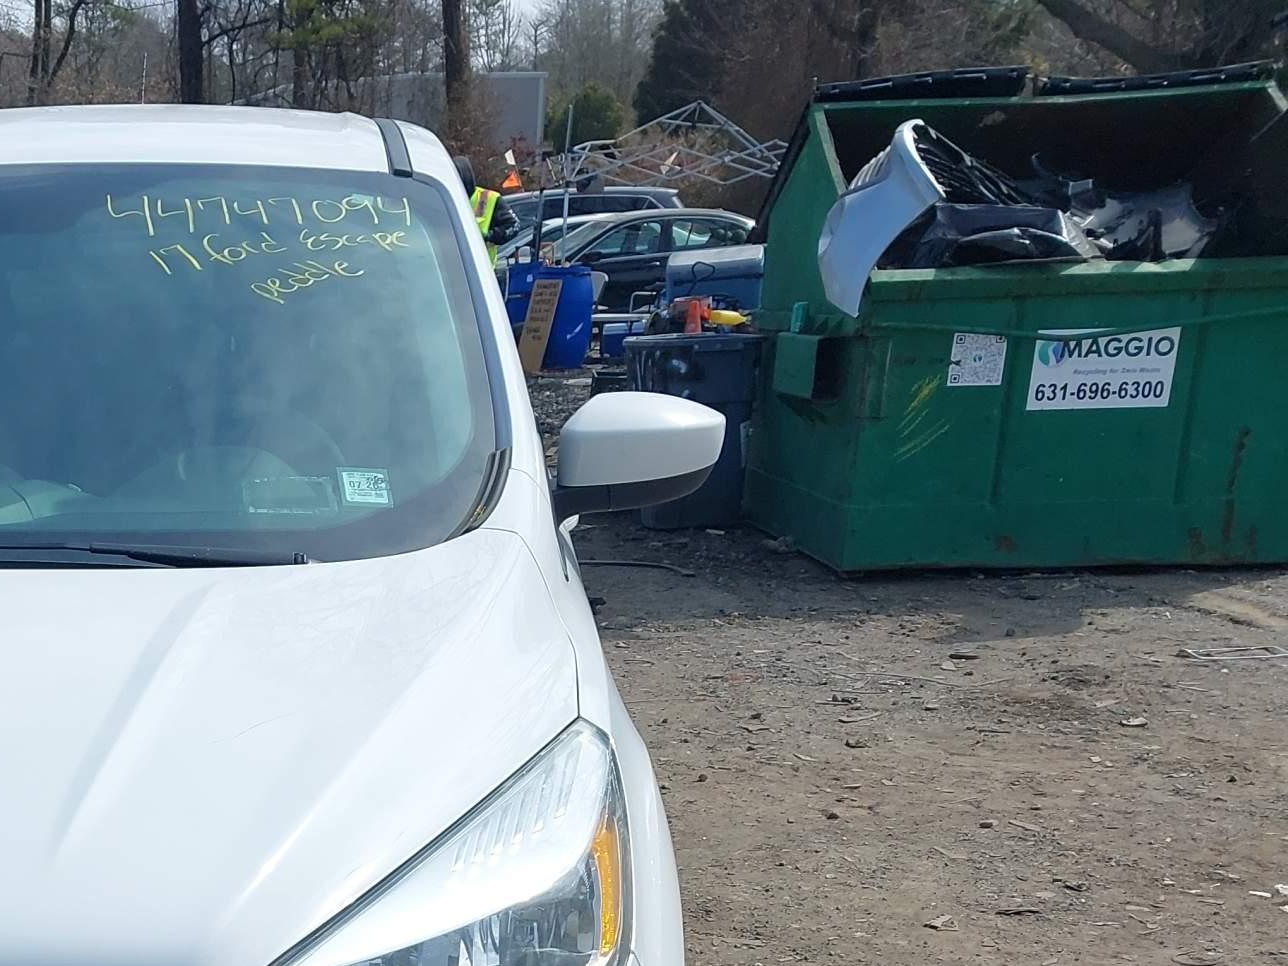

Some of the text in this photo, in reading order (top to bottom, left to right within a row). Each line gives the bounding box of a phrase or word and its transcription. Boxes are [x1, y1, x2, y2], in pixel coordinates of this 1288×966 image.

[106, 194, 411, 236] 44747094
[149, 244, 203, 275] 17
[1060, 335, 1176, 360] MAGGIO
[1034, 380, 1165, 402] 631-696-6300
